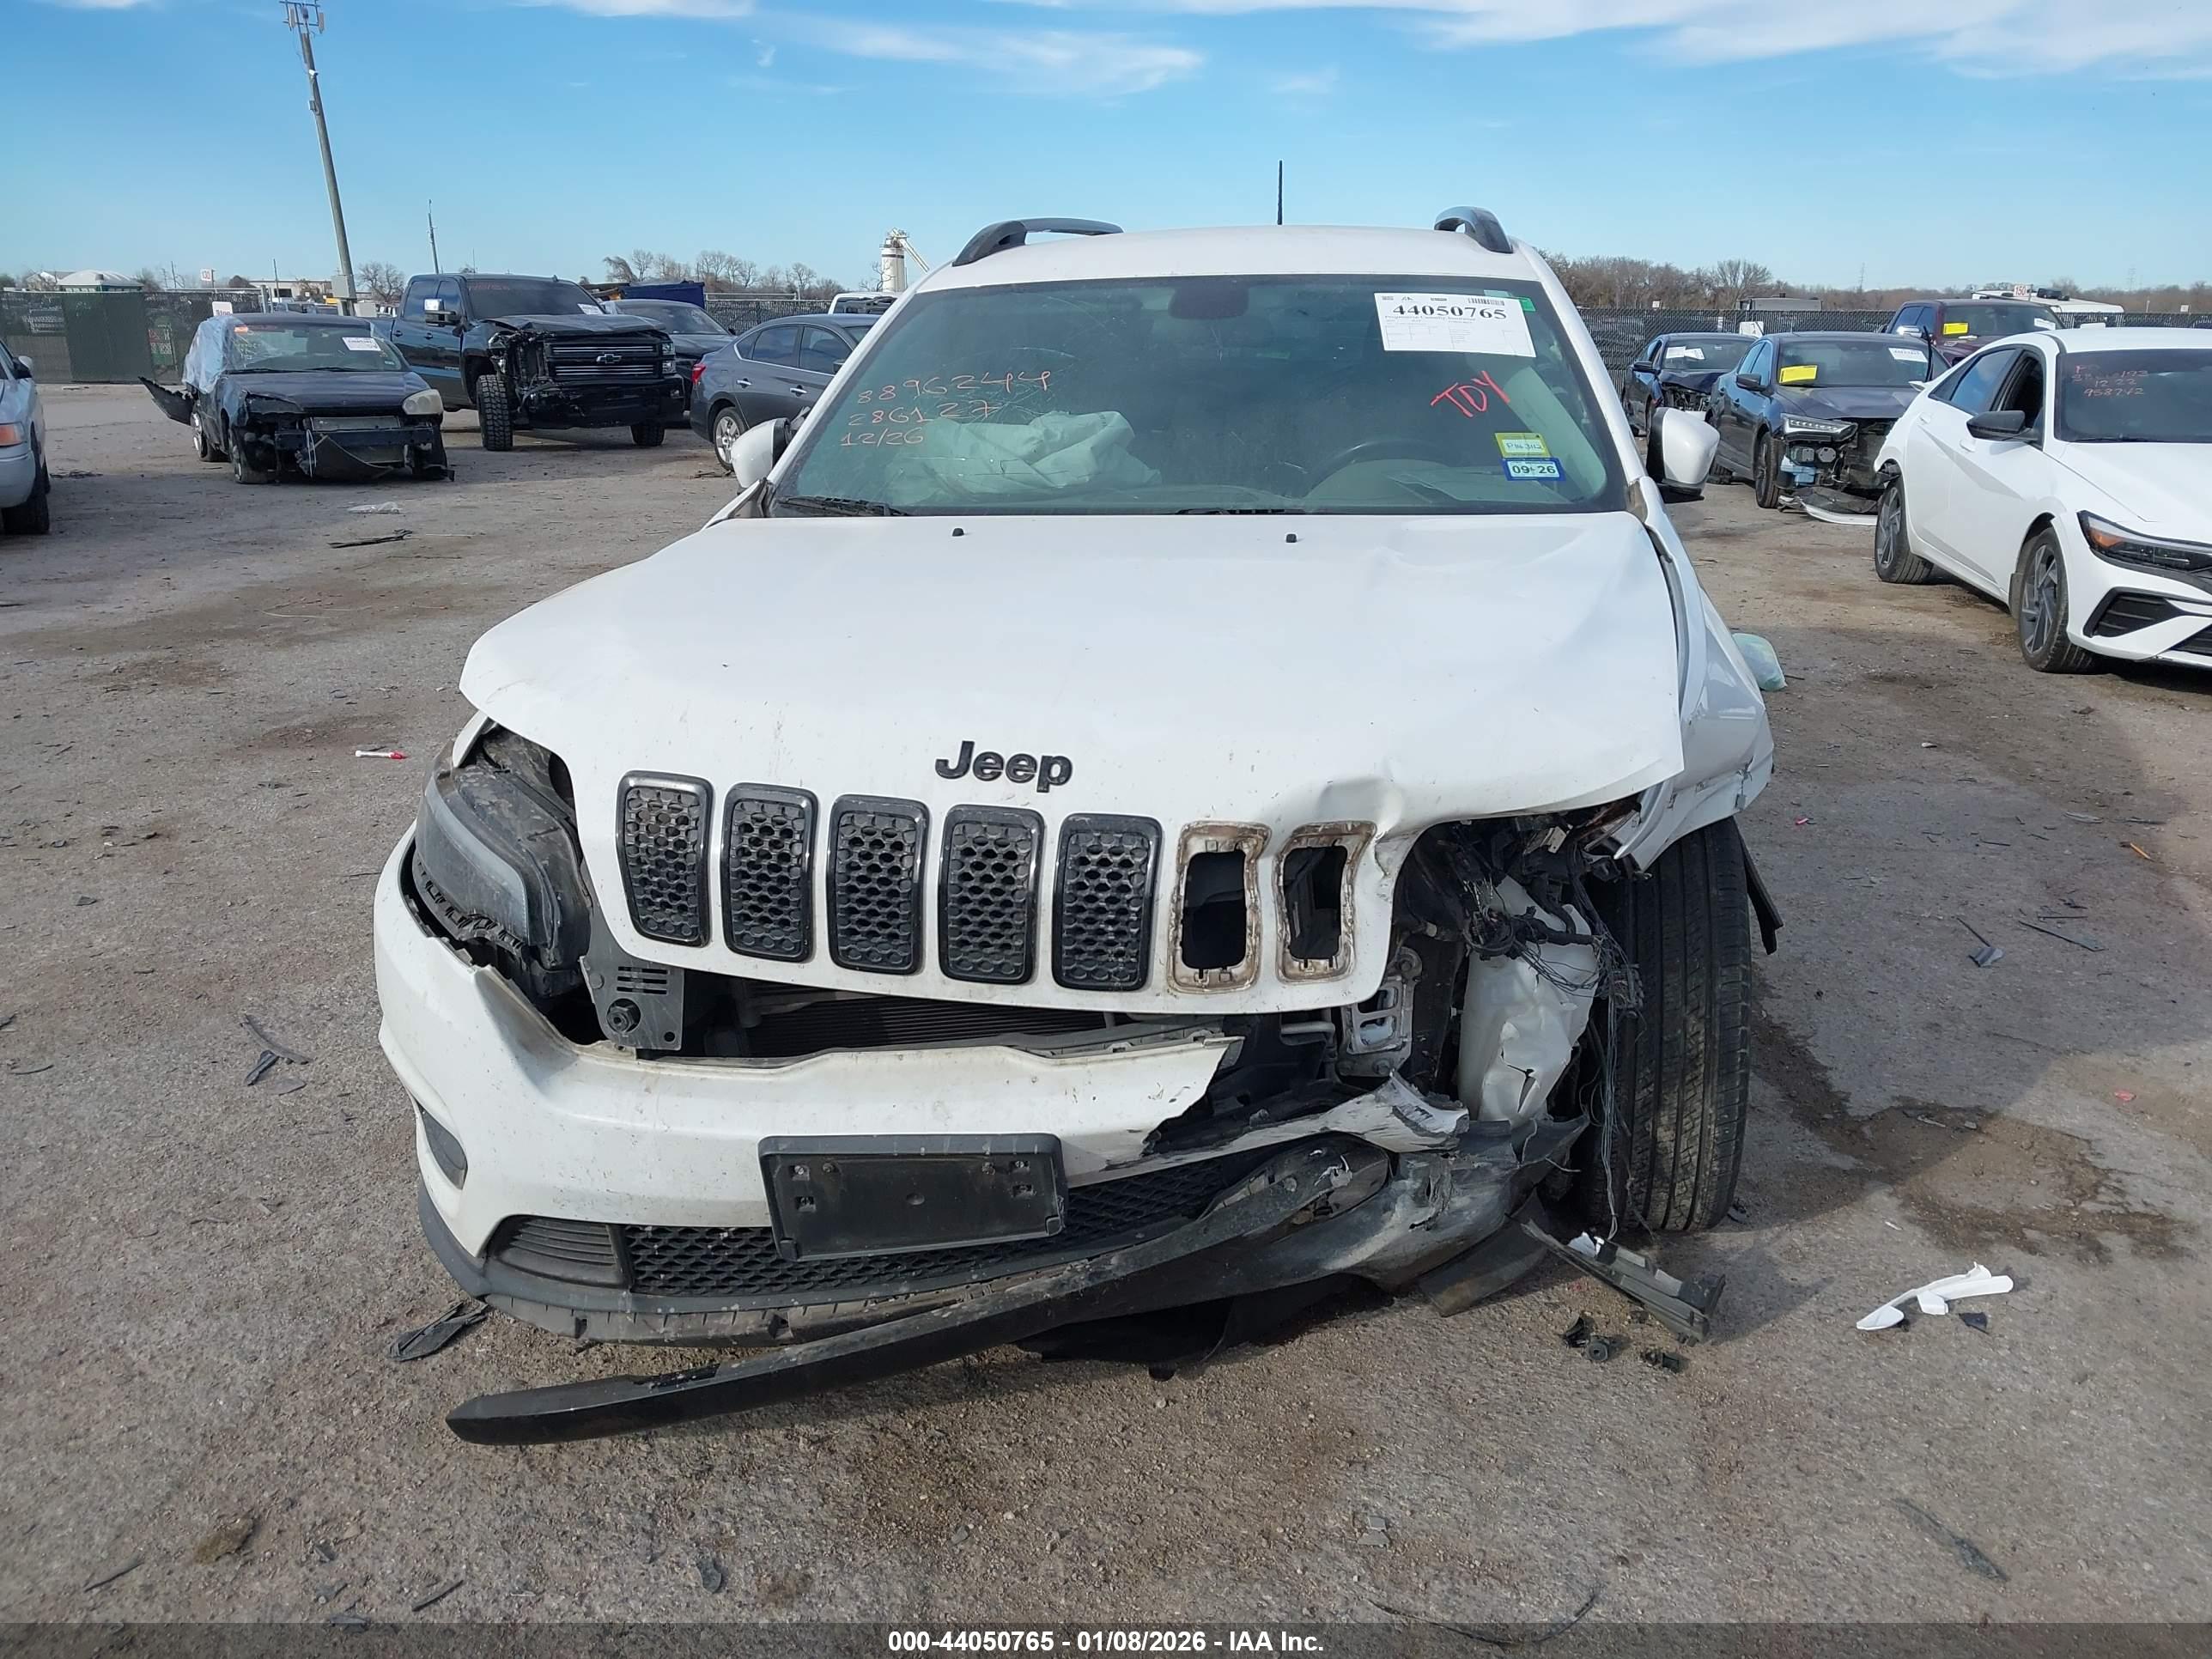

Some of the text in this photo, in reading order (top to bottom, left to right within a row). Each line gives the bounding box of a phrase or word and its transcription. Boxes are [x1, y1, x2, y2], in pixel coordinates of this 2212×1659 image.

[2014, 284, 2027, 296] 150
[1392, 304, 1508, 320] 44050765
[858, 370, 1052, 404] 8896244
[1430, 370, 1511, 418] TDY
[841, 427, 924, 447] 12/26
[1511, 465, 1557, 475] 09 26
[934, 740, 1073, 793] Jeep
